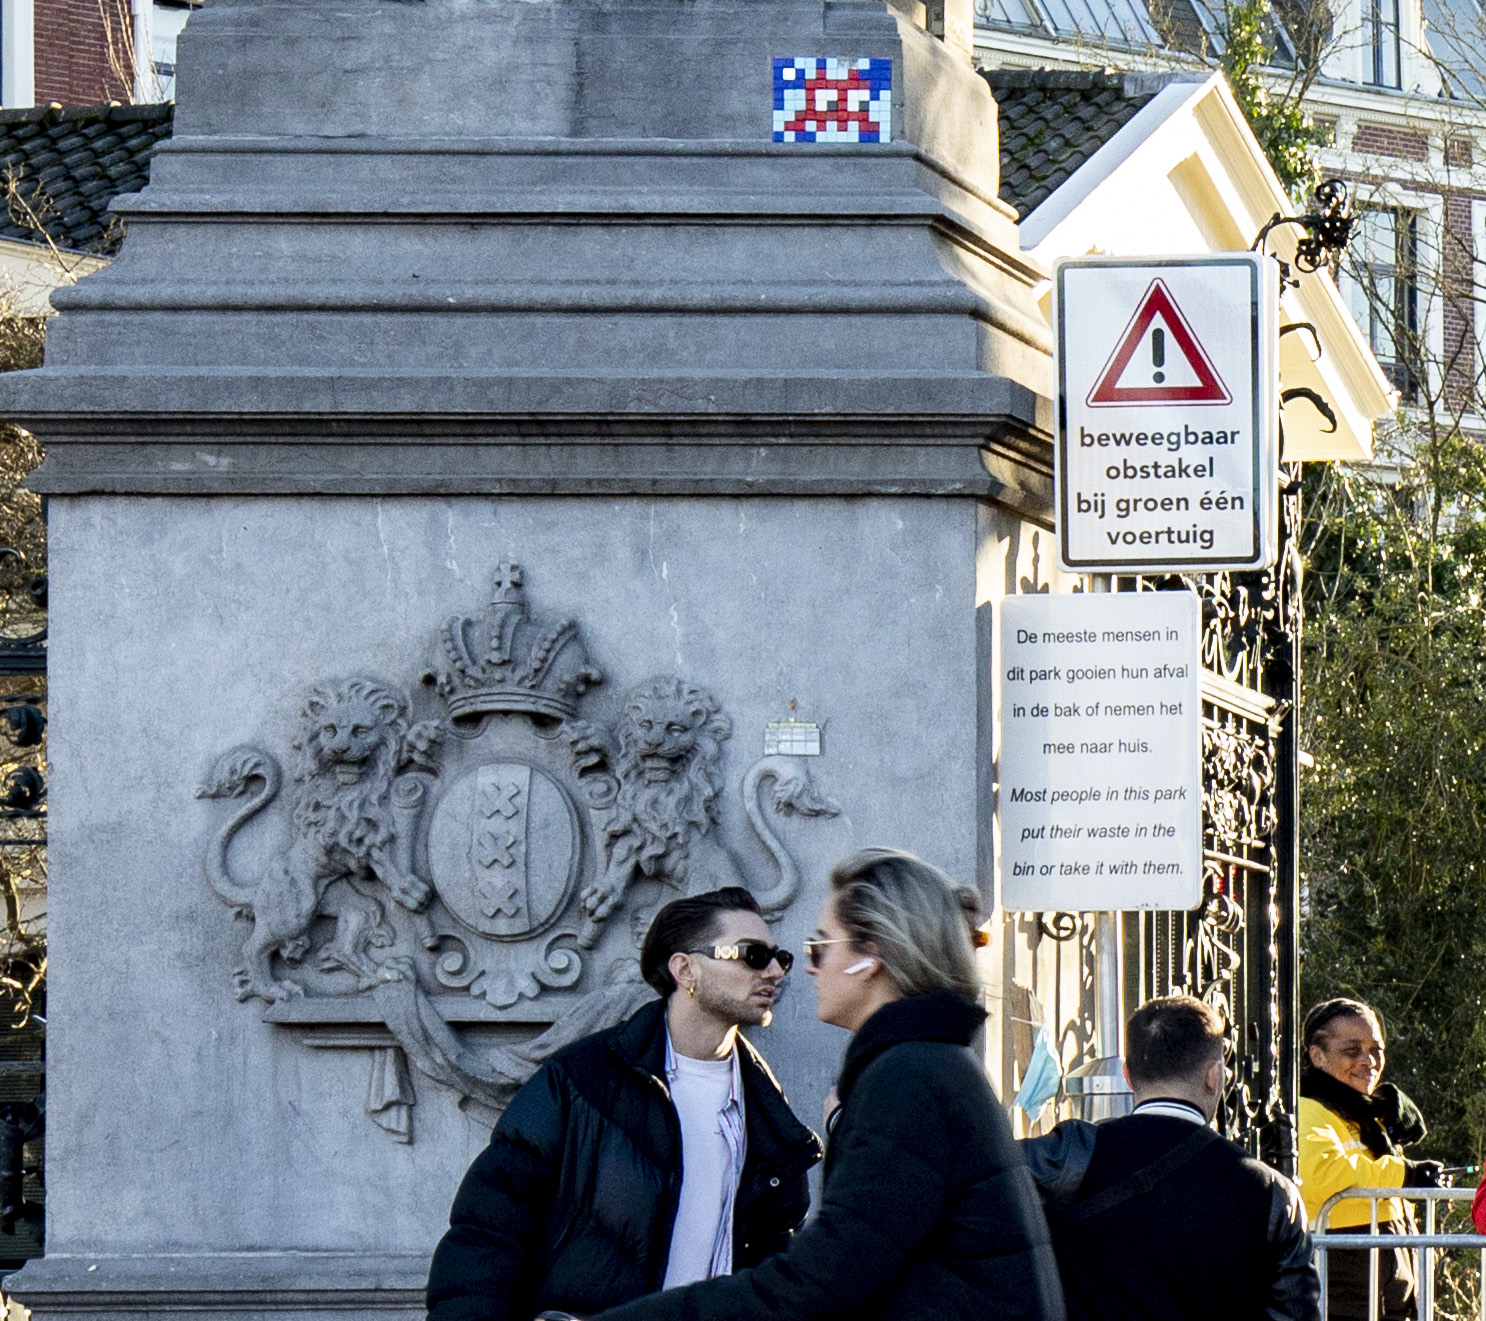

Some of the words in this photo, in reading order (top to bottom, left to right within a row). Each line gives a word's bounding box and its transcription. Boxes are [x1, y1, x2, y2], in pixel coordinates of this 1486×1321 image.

[1079, 424, 1241, 453] beweegbaar
[1105, 456, 1214, 481] obstakel
[1076, 492, 1106, 521] bij
[1115, 497, 1190, 520] groen
[1199, 490, 1245, 512] één
[1106, 524, 1214, 551] voertuig
[1016, 629, 1038, 645] De
[1042, 630, 1097, 644] meeste
[1102, 630, 1161, 643] mensen
[1166, 627, 1179, 642] in
[1006, 666, 1025, 682] dit
[1029, 666, 1061, 685] park
[1066, 666, 1116, 684] gooien
[1121, 665, 1149, 680] hun
[1153, 664, 1189, 679] afval
[1012, 703, 1026, 719] in
[1030, 703, 1049, 718] de
[1054, 703, 1081, 718] bak
[1085, 702, 1100, 717] of
[1104, 704, 1155, 717] nemen
[1159, 702, 1183, 716] het
[1042, 743, 1076, 755] mee
[1080, 743, 1114, 754] naar
[1118, 739, 1153, 754] huis.
[1010, 787, 1048, 803] Most
[1050, 787, 1102, 805] people
[1105, 786, 1119, 802] in
[1123, 786, 1150, 802] this
[1153, 786, 1187, 804] park
[1020, 825, 1046, 843] put
[1049, 825, 1083, 840] their
[1086, 825, 1131, 839] waste
[1134, 823, 1148, 839] in
[1152, 823, 1176, 838] the
[1012, 861, 1036, 878] bin
[1039, 864, 1056, 877] or
[1059, 862, 1091, 877] take
[1095, 862, 1104, 876] it
[1108, 861, 1138, 876] with
[1142, 861, 1184, 876] them.
